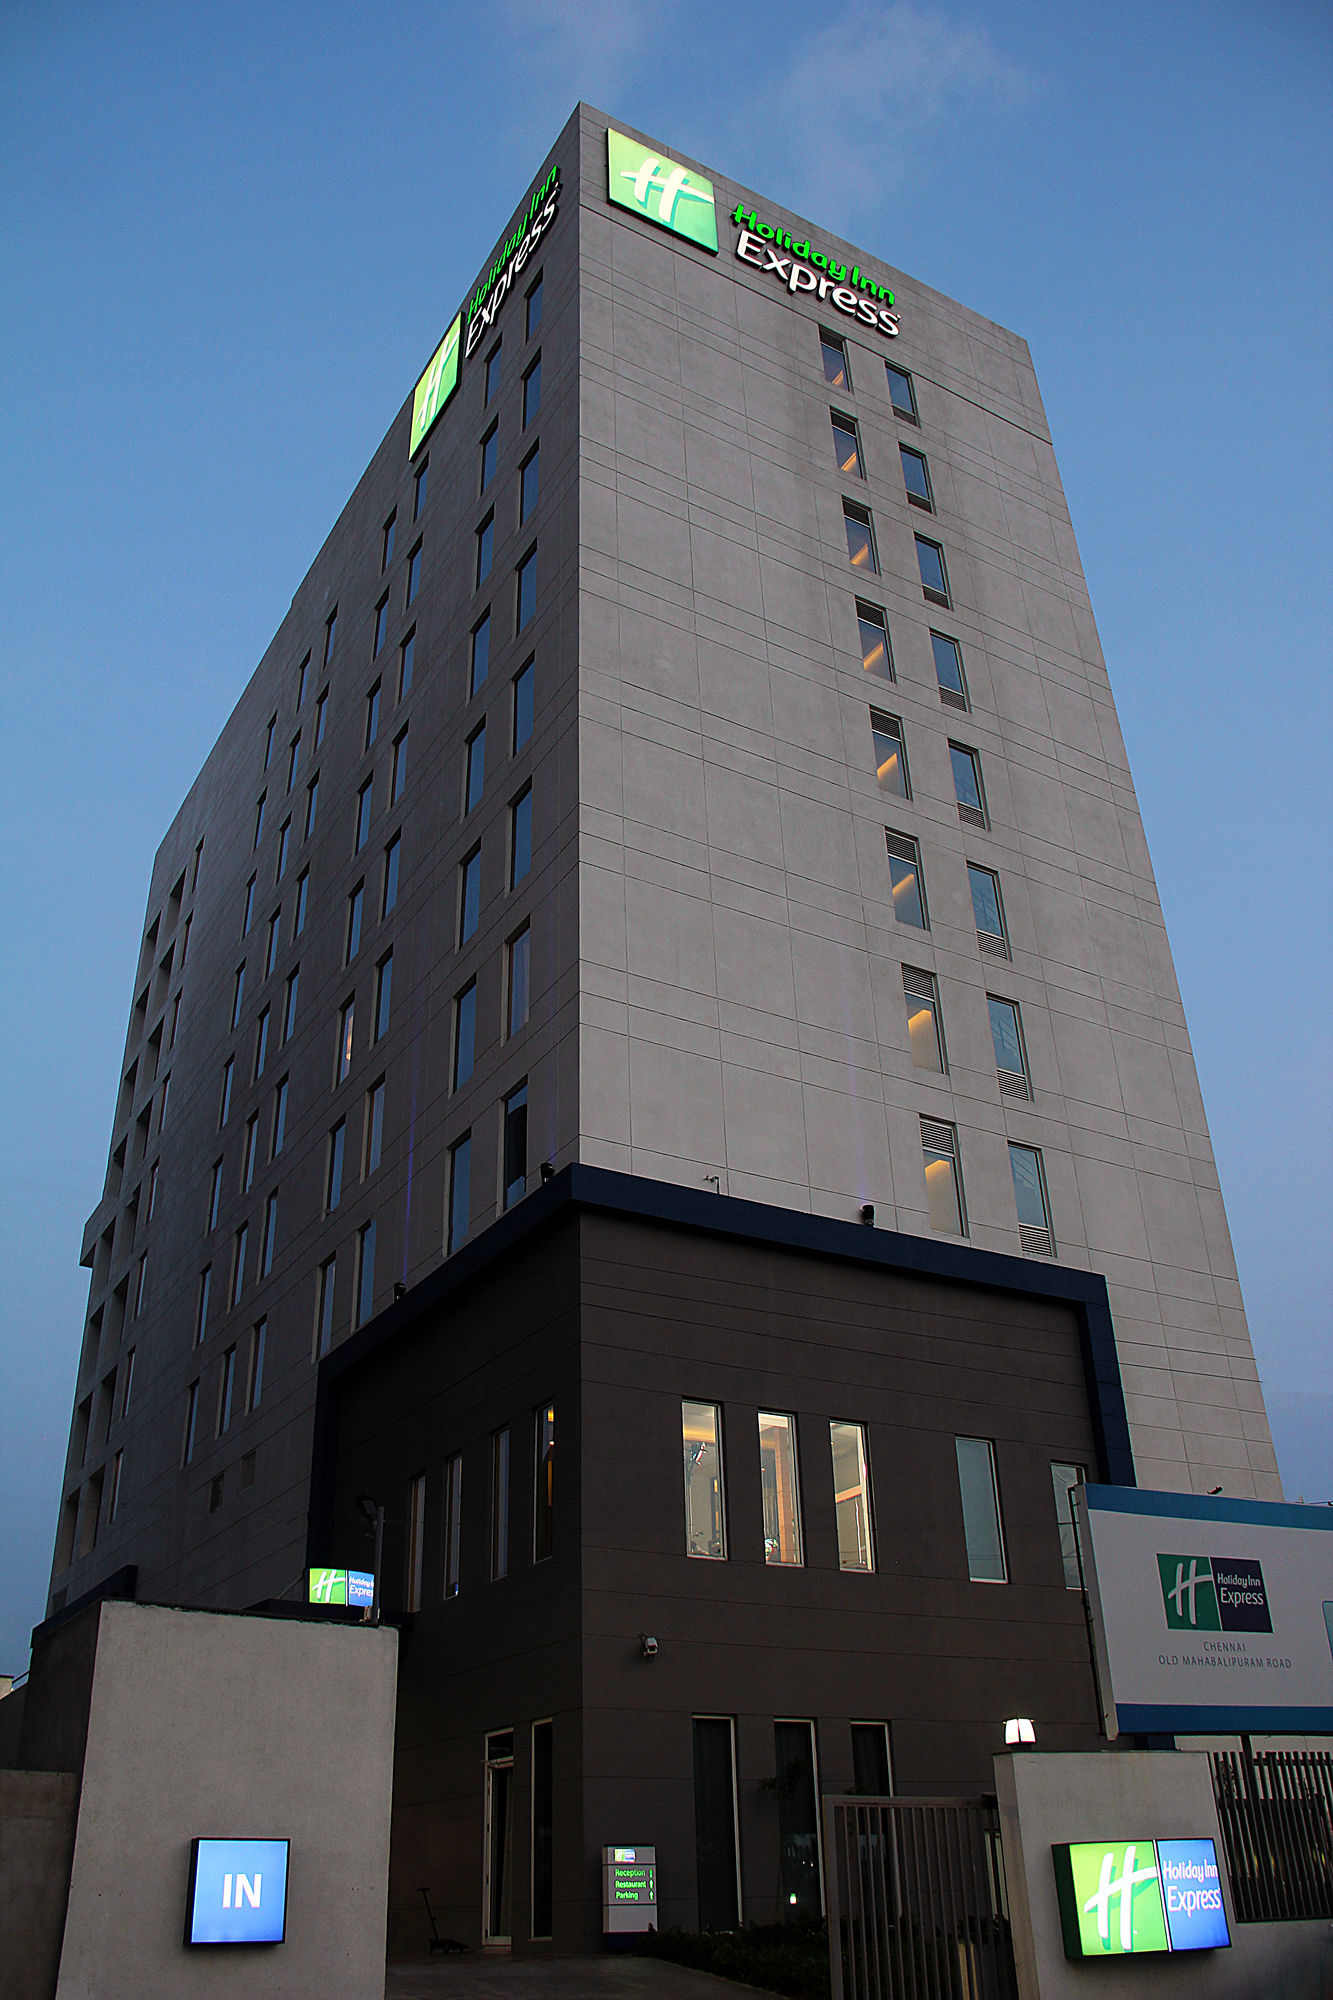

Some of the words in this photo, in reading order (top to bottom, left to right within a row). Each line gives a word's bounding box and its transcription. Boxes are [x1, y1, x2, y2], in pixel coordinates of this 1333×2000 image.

[467, 212, 528, 325] Holiday
[529, 165, 557, 220] Inn
[731, 203, 847, 281] Holiday
[852, 266, 896, 305] Inn
[465, 187, 557, 358] Express
[736, 229, 900, 336] Express
[349, 1576, 371, 1589] Holiday
[1217, 1573, 1248, 1588] Holiday
[1248, 1574, 1261, 1587] Inn
[1221, 1587, 1264, 1608] Express
[1203, 1641, 1246, 1653] CHENNAI
[1158, 1655, 1178, 1665] OLD
[1182, 1656, 1263, 1668] MAHABALIPURAM
[1266, 1658, 1292, 1669] ROAD
[615, 1868, 646, 1878] Reception
[1162, 1860, 1204, 1883] Holiday
[1204, 1859, 1218, 1879] Inn
[222, 1873, 262, 1909] IN
[615, 1880, 647, 1889] Restaurant
[615, 1891, 639, 1901] Parking
[1167, 1886, 1221, 1917] Express
